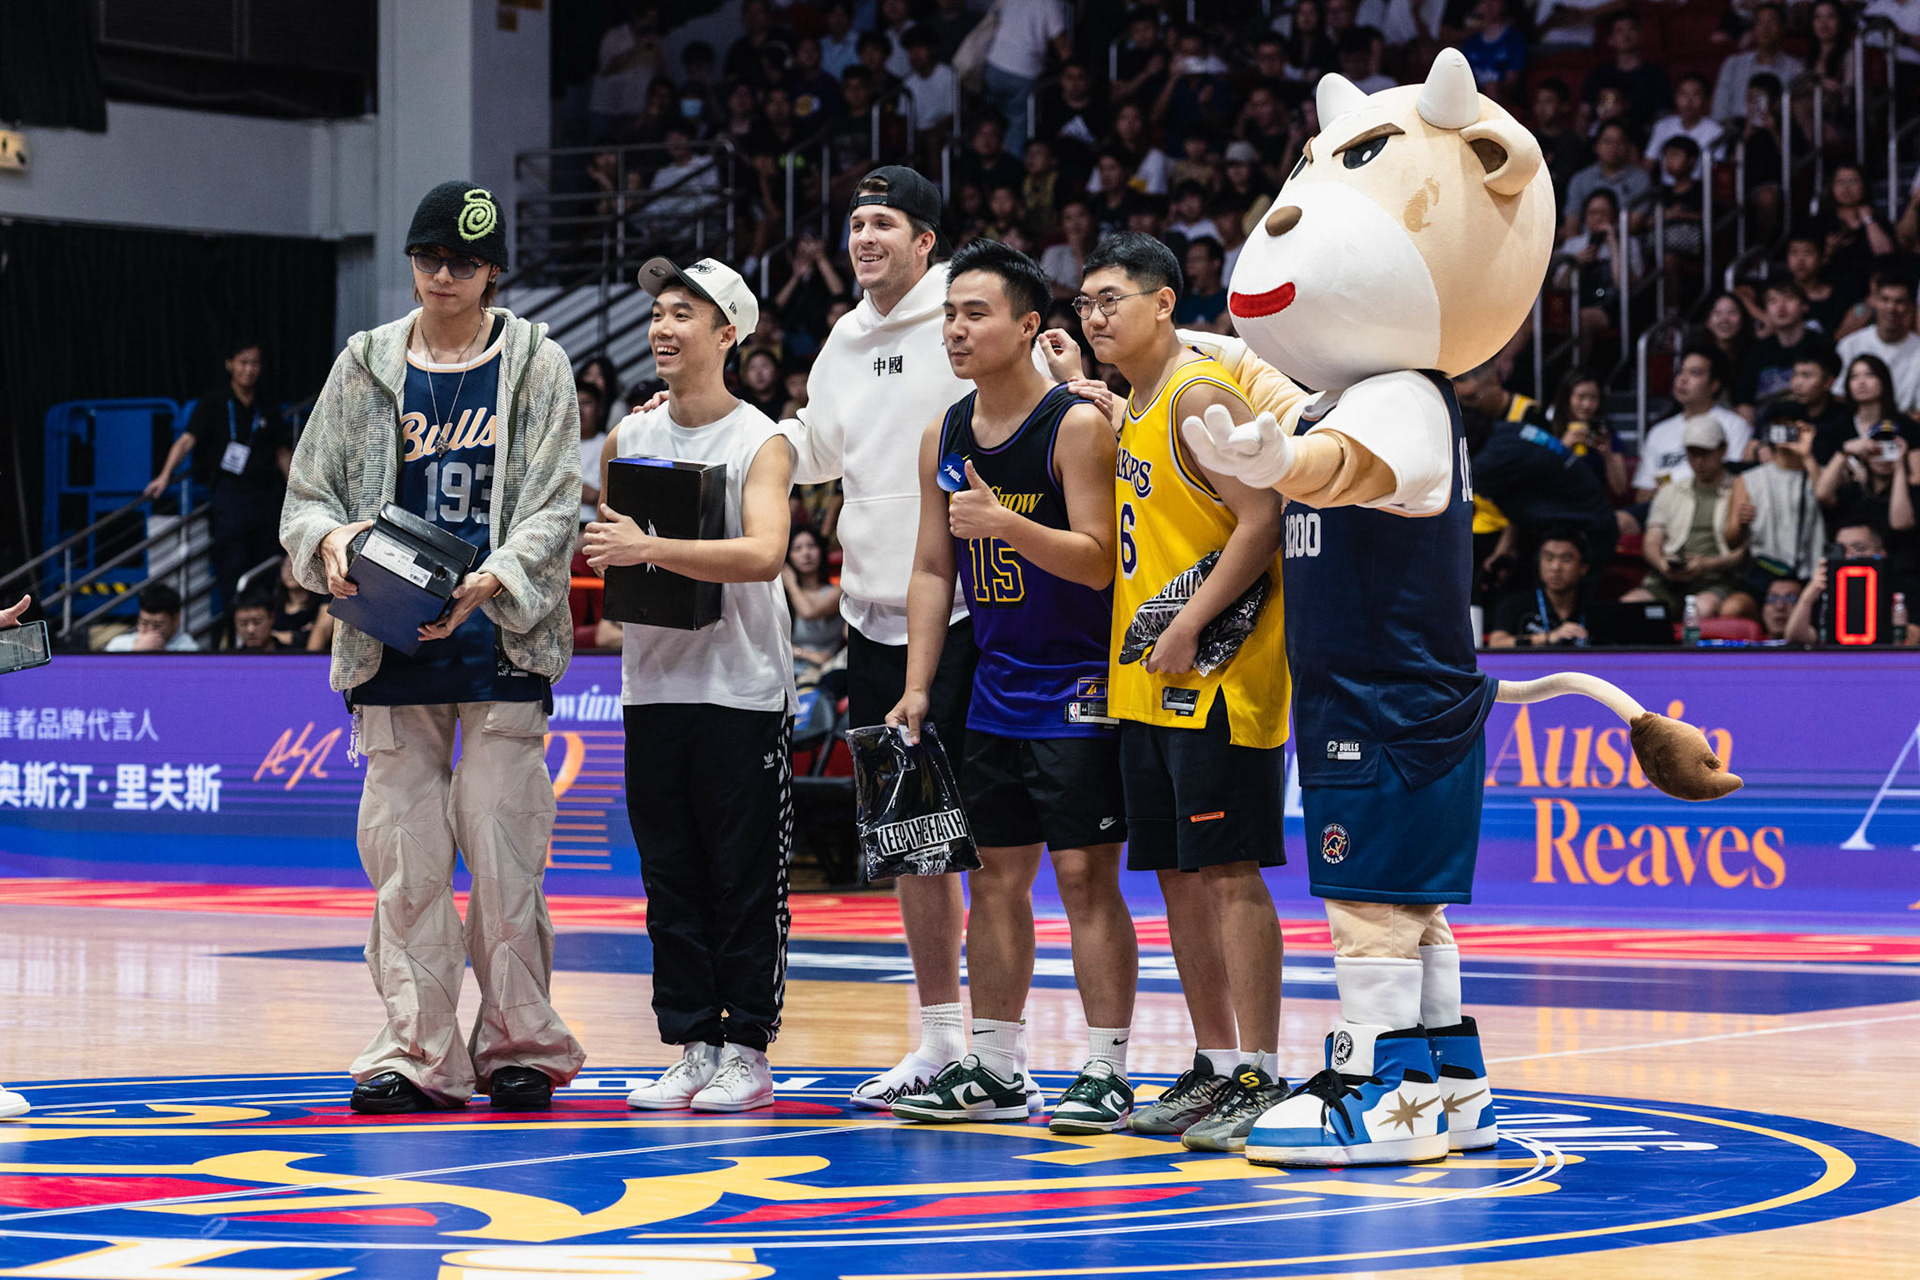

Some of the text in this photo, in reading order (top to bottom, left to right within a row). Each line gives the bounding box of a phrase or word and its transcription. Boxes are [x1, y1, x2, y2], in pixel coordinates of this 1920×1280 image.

[873, 355, 903, 377] 中國
[401, 407, 497, 462] Bulls
[1120, 502, 1138, 580] 6
[1285, 513, 1321, 558] 1000
[969, 537, 1026, 603] 15
[1836, 566, 1878, 646] 0
[1339, 742, 1360, 752] BULLS
[1532, 797, 1787, 889] Reaves
